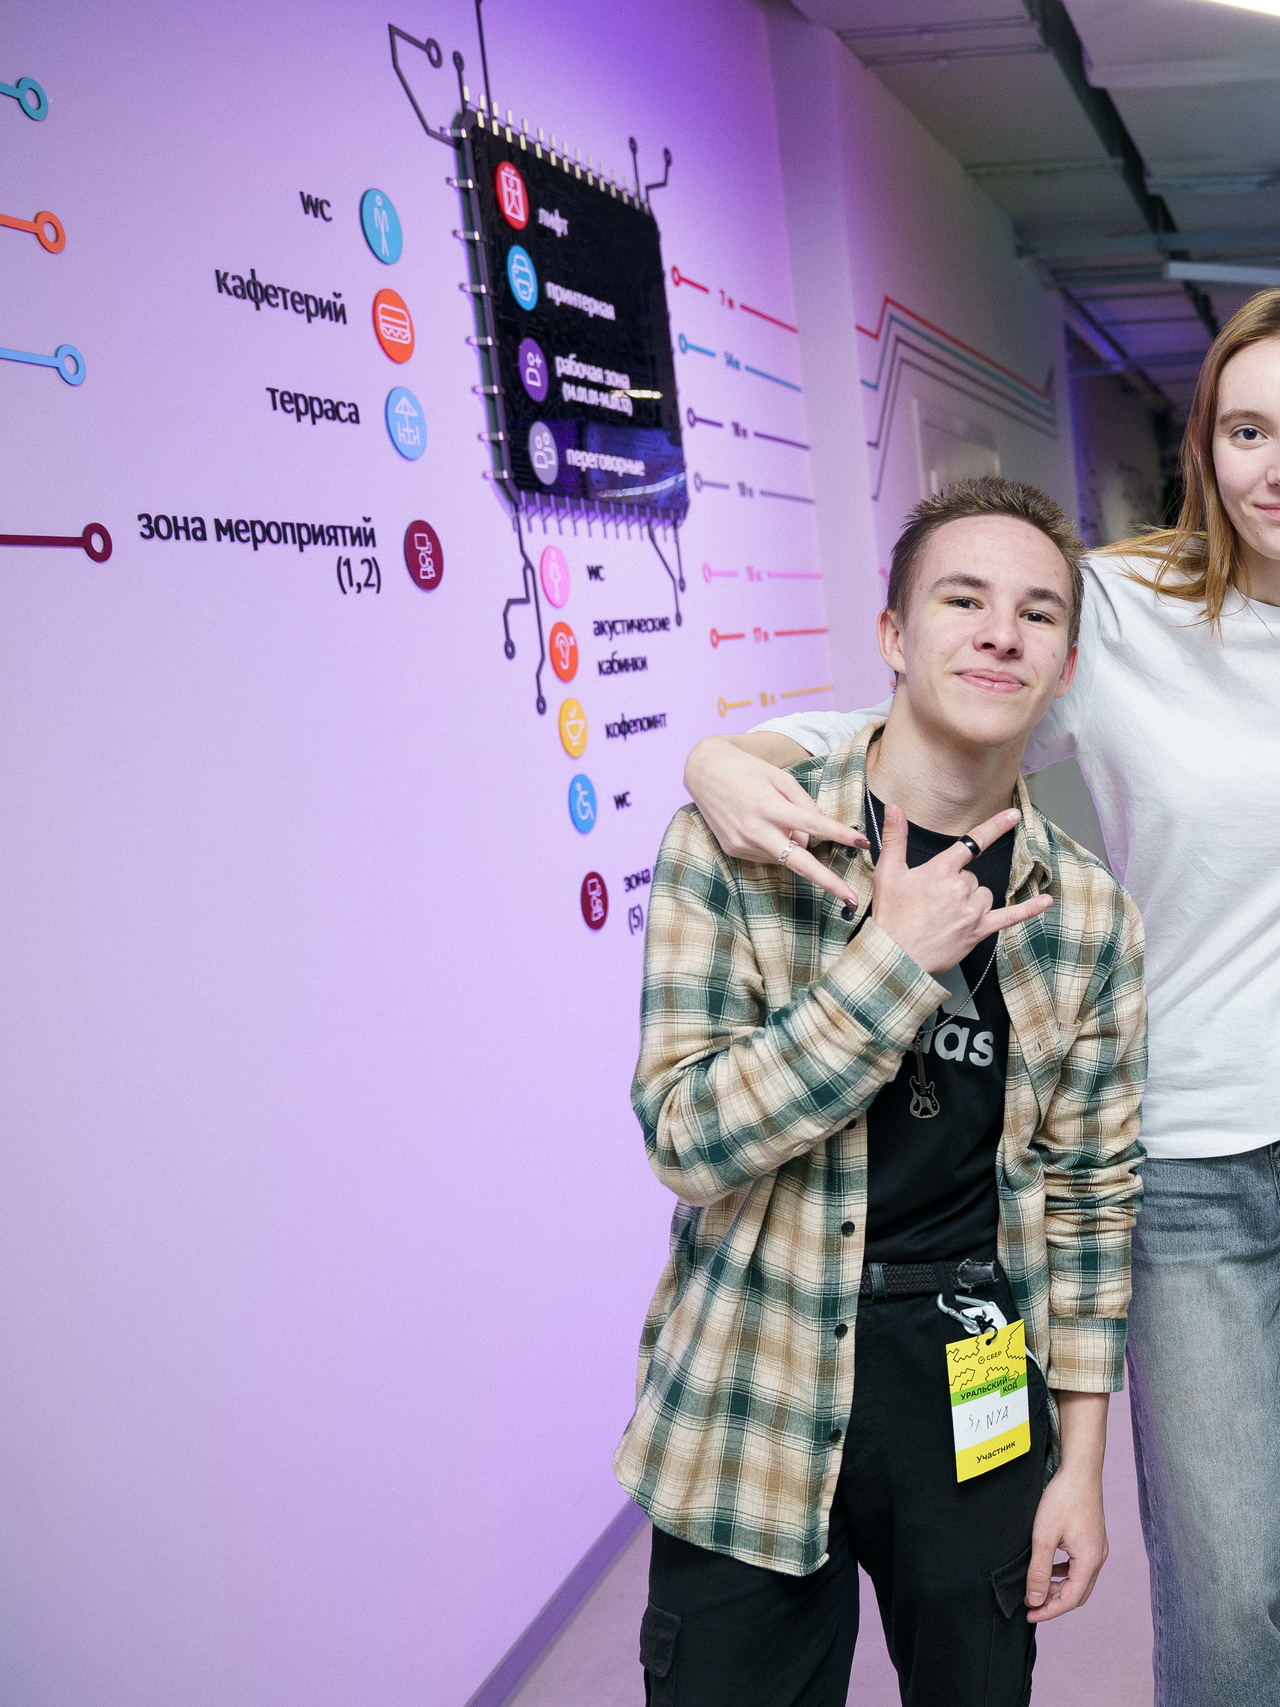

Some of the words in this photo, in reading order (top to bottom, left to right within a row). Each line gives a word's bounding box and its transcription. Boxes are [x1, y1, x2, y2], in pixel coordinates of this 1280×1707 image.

[214, 268, 348, 325] кафетерий
[265, 386, 361, 426] терраса
[565, 448, 646, 478] переговорные
[137, 513, 208, 542] зона
[213, 516, 377, 553] мероприятий
[336, 555, 382, 595] (1,2)
[593, 616, 671, 642] акустические
[597, 650, 649, 677] кабинки
[605, 712, 668, 741] кофепоинт
[623, 868, 652, 893] зона
[628, 903, 644, 936] (5)
[986, 1350, 1002, 1362] СБЕР
[960, 1376, 1008, 1400] УРАЛЬСКИЙ
[1002, 1381, 1018, 1394] КОД
[976, 1440, 1016, 1464] Участник
